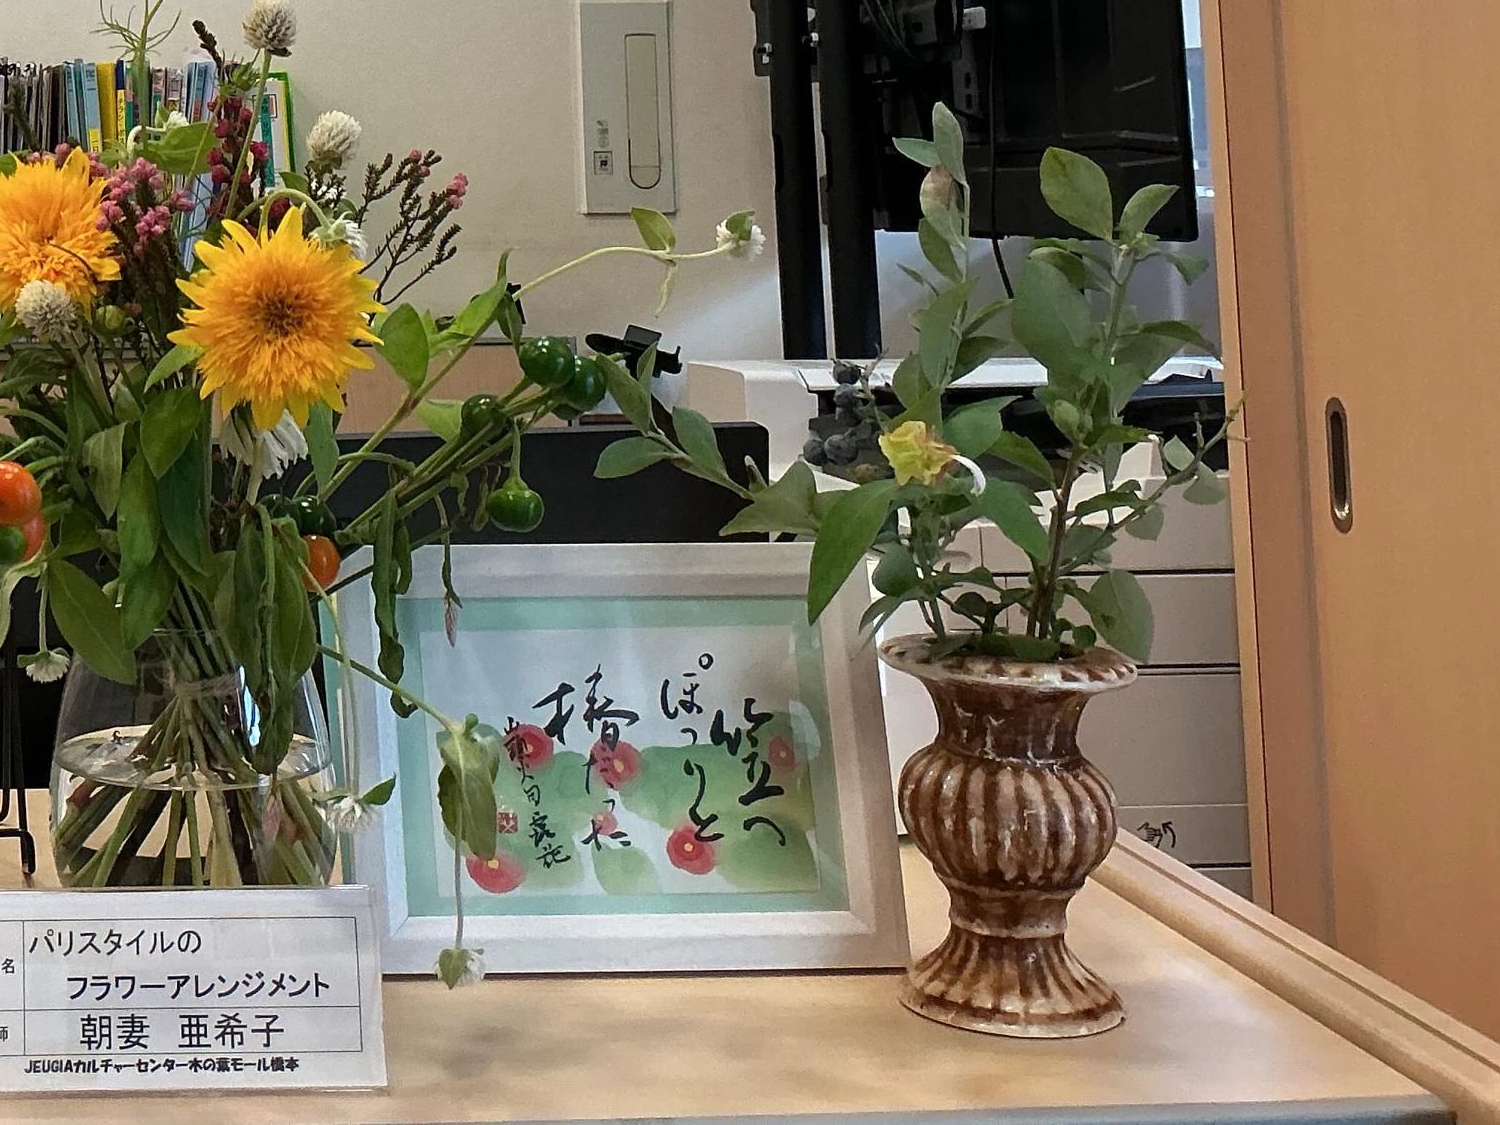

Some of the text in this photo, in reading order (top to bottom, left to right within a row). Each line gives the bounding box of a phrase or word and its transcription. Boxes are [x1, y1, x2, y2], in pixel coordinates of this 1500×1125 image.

[29, 929, 202, 955] パリスタイルの
[67, 972, 330, 1000] フラワーアレンジメント
[80, 1013, 285, 1050] 朝妻 亜希子
